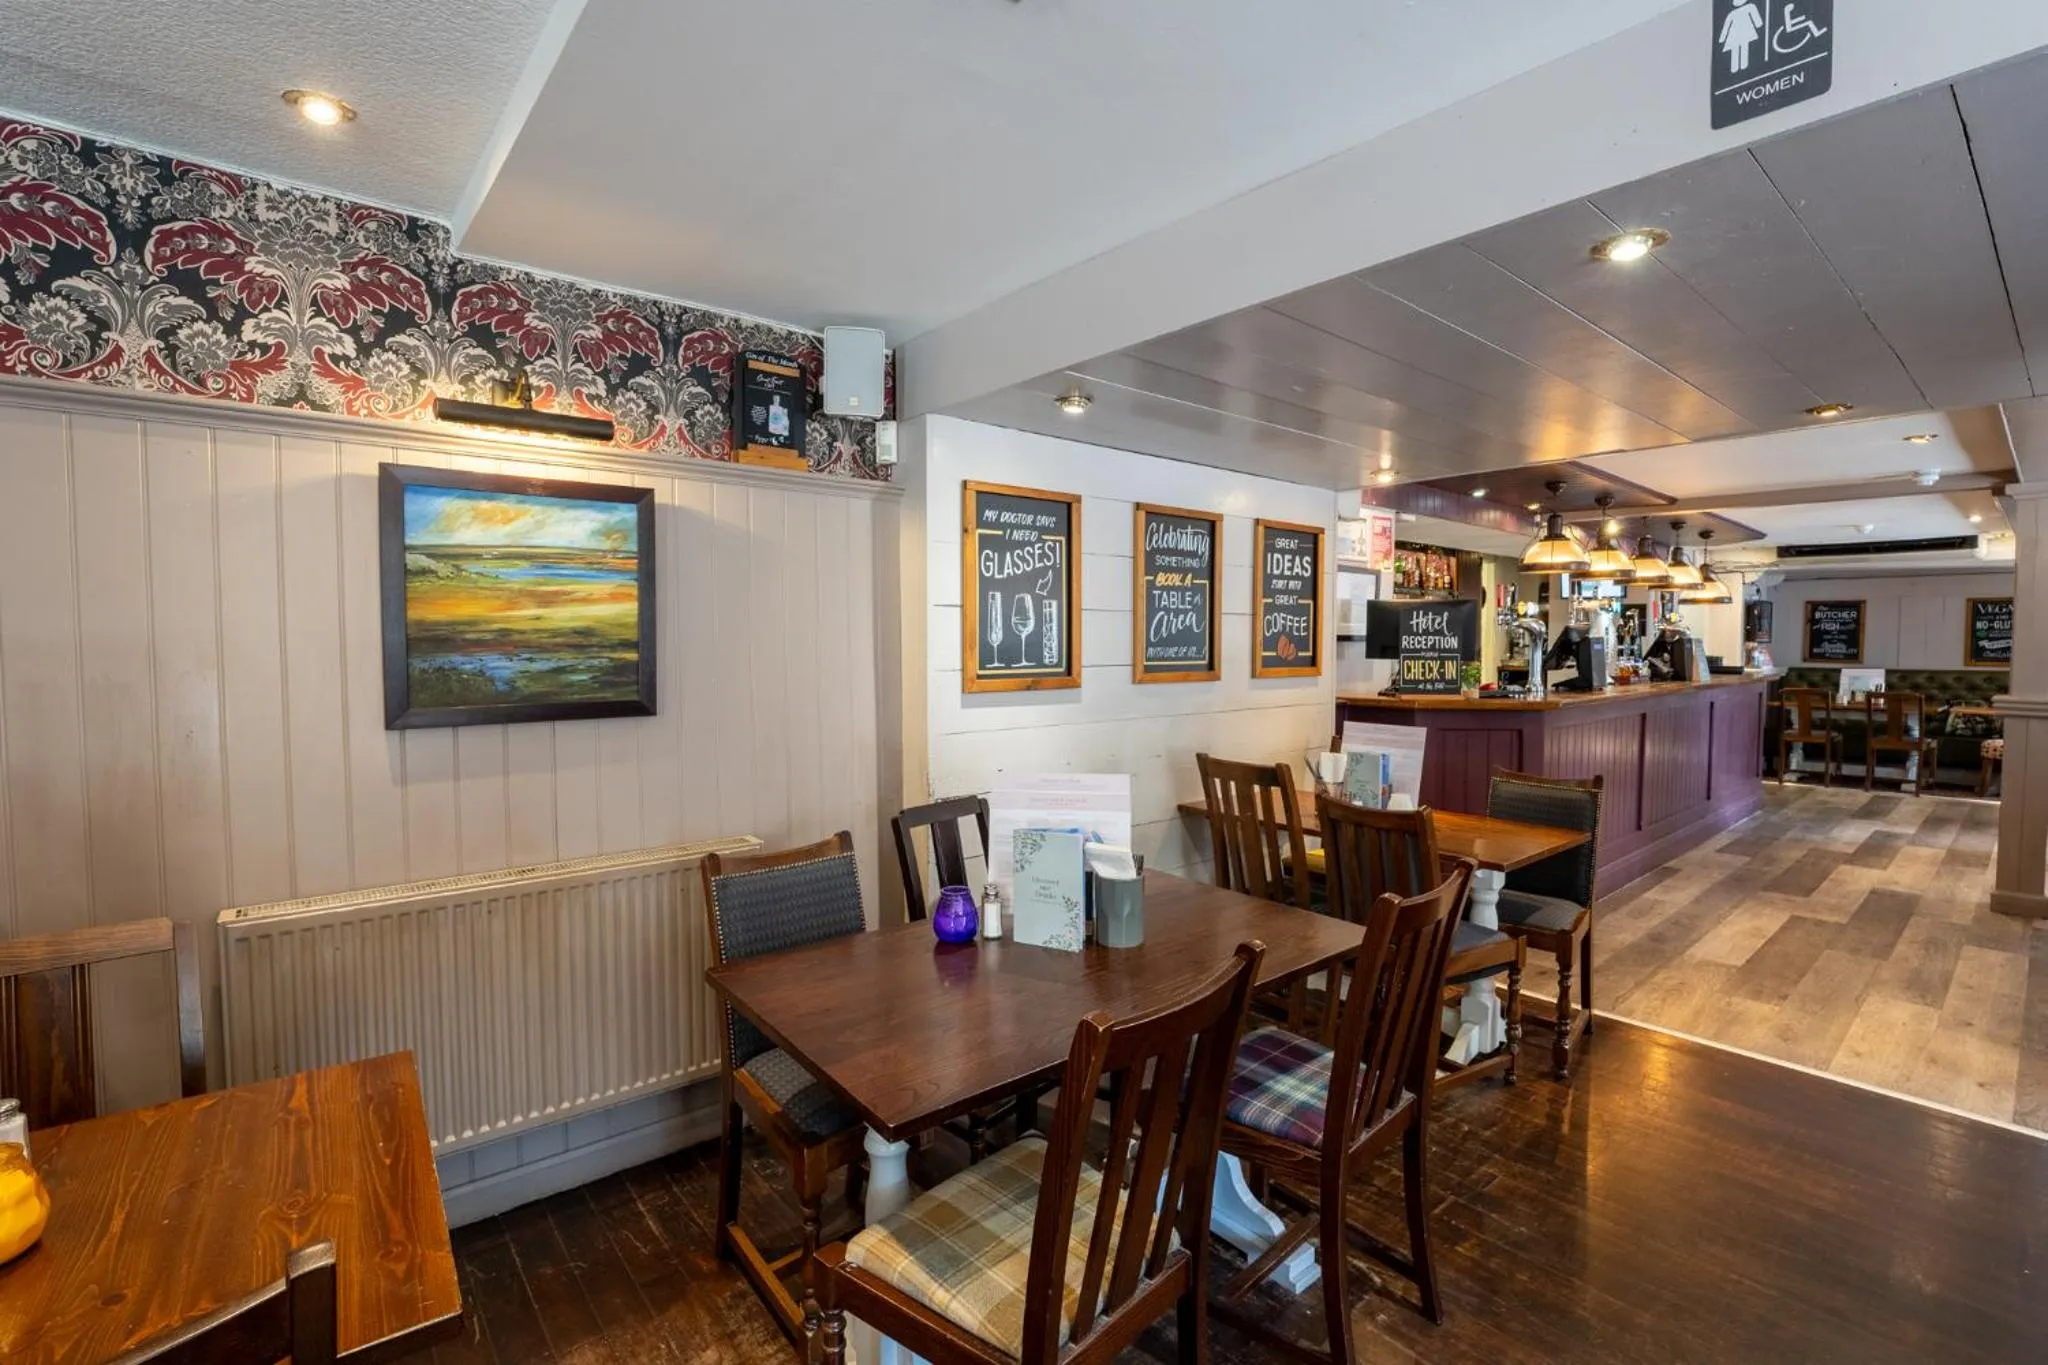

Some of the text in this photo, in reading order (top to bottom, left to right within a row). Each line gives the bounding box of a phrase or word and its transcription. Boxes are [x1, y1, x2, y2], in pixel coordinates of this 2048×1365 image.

[1736, 71, 1805, 105] WOMEN
[983, 509, 1056, 528] MY DOCTOR SAYS
[1005, 529, 1039, 542] I NEED
[1274, 537, 1299, 550] GREAT
[1146, 522, 1210, 569] Celebrating
[981, 541, 1061, 579] GLASSES!
[1155, 554, 1200, 569] SOMETHING
[1267, 552, 1312, 577] IDEAS
[1155, 571, 1193, 588] BOOK A
[1152, 590, 1193, 609] TABLE
[1274, 594, 1298, 605] GREAT
[1409, 610, 1454, 636] Hotel
[1814, 610, 1858, 619] BUTCHER
[1264, 612, 1308, 637] COFFEE
[1976, 620, 2011, 629] NO-GLU
[1401, 635, 1458, 650] RECEPTION
[1404, 659, 1457, 680] CHECK-IN
